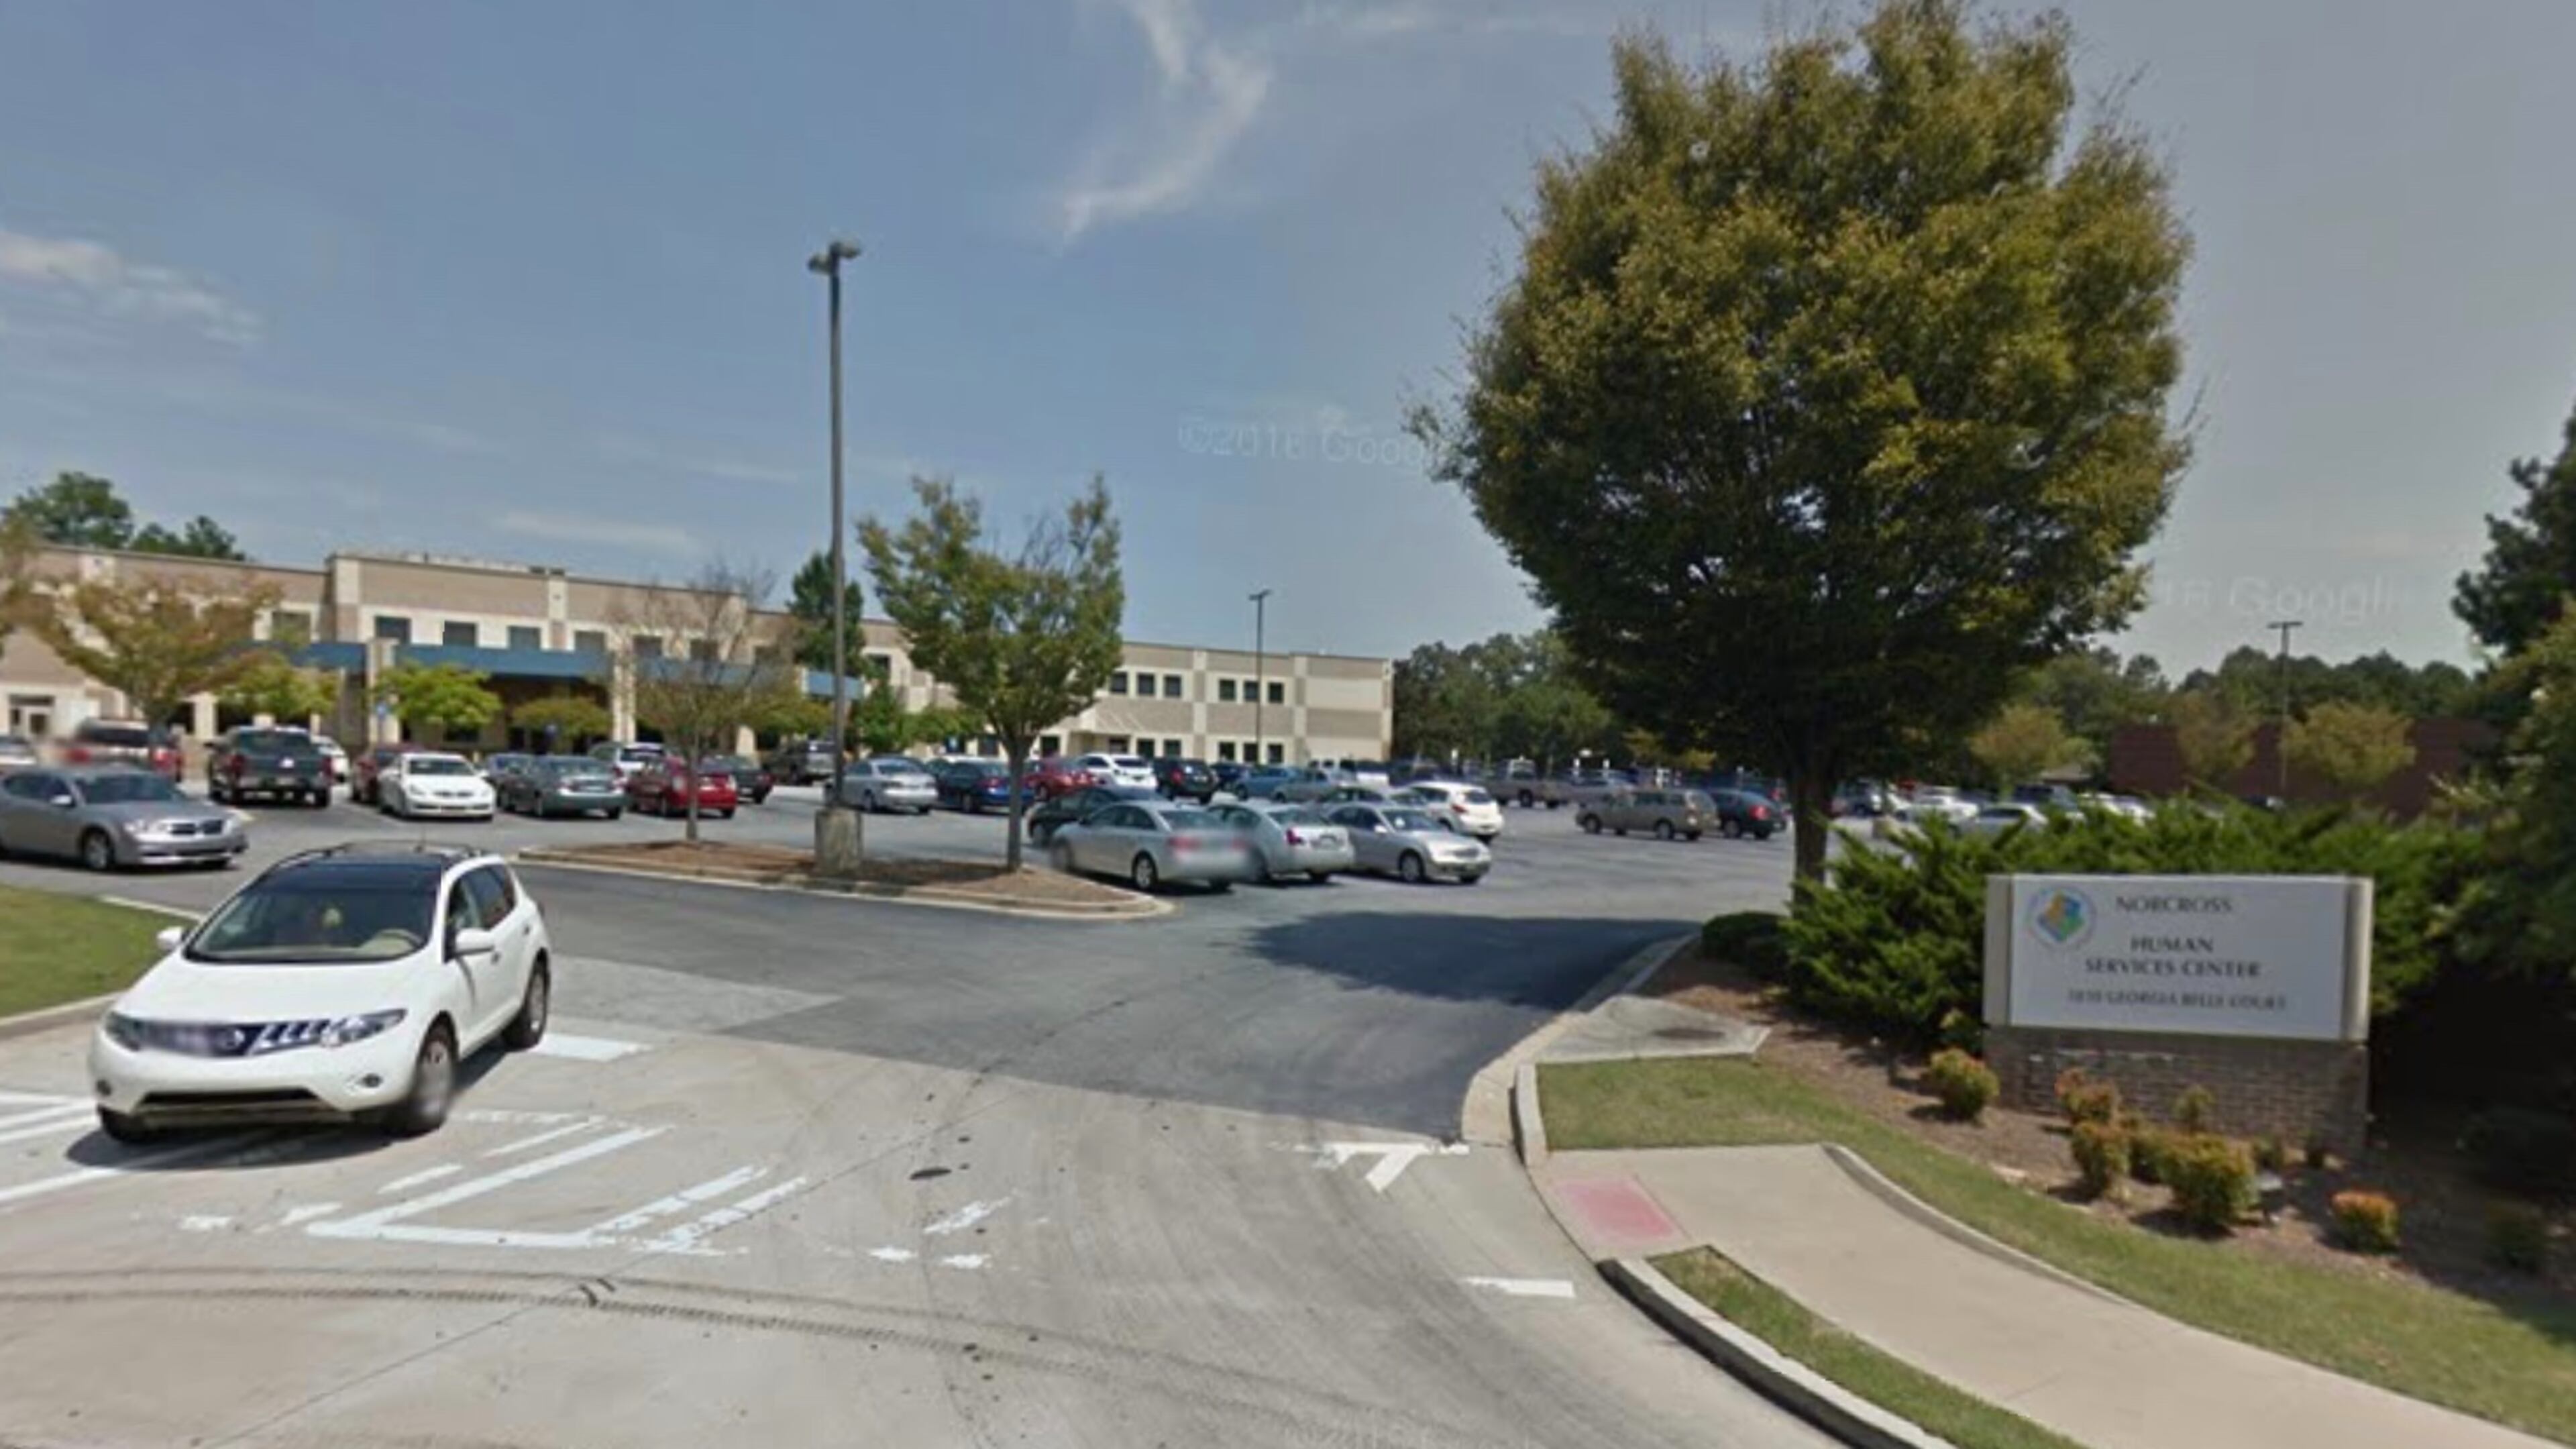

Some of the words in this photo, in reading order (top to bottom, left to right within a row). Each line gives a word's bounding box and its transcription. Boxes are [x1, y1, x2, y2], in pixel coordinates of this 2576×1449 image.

[2116, 896, 2233, 914] NORCROSS
[2131, 936, 2214, 953] HUMAN
[2085, 958, 2174, 976] SERVICES
[2182, 960, 2261, 978] CENTER
